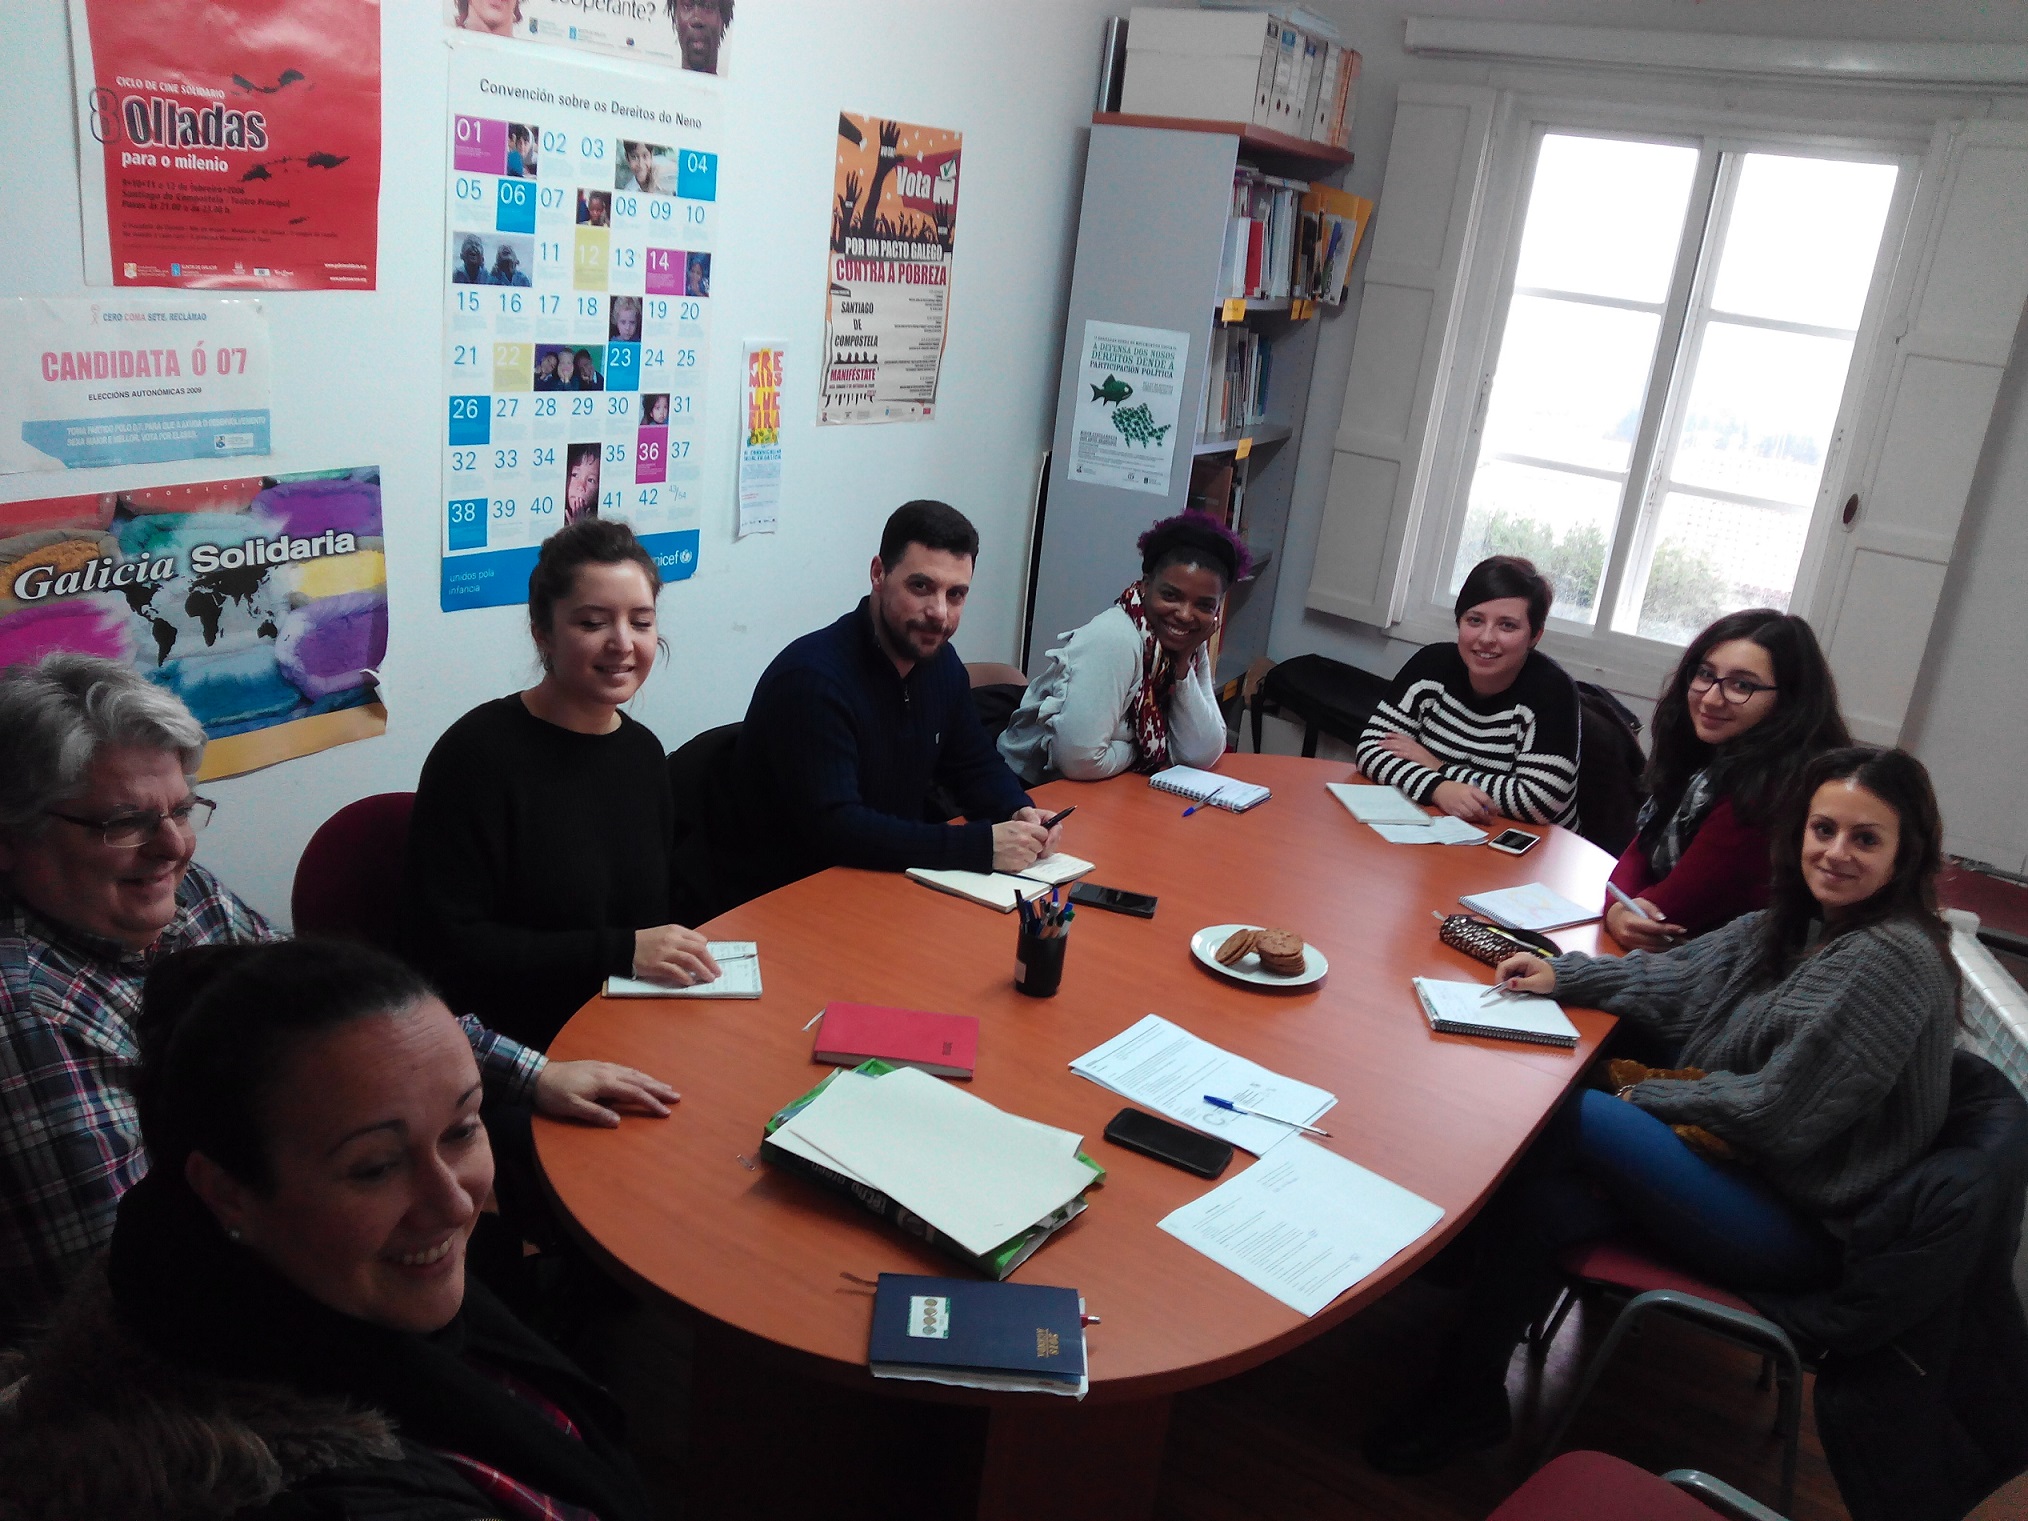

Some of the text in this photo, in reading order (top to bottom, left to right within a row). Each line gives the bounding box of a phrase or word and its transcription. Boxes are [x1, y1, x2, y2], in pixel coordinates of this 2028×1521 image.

[116, 76, 225, 99] CICLO DE CINE SOLIDARIO
[480, 78, 702, 129] Convención sobre os Dereitos do Neno
[122, 95, 268, 152] Olladas
[457, 118, 708, 174] 01 02 03 04
[122, 151, 229, 172] para o milenio
[897, 165, 932, 199] Vota
[456, 178, 705, 224] 05 06 07 08 09 10
[542, 242, 669, 271] 11 12 13 14
[845, 236, 942, 261] POR UN PACTO GALEGO
[836, 258, 947, 286] CONTRA A POBREZA
[103, 313, 123, 321] CERO
[457, 291, 700, 320] 15 16 17 18 19 20
[841, 301, 874, 314] SANTIAGO
[853, 319, 862, 330] DE
[835, 335, 878, 347] COMPOSTELA
[1092, 341, 1098, 349] A
[1134, 348, 1148, 357] DOS
[41, 348, 181, 382] CANDIDATA
[191, 340, 206, 377] Ó
[454, 346, 695, 367] 21 22 23 24 25
[1091, 350, 1174, 370] DEREITOS DENDE A
[88, 391, 130, 401] ELECCIONS
[132, 387, 185, 399] AUTONÓMICAS
[453, 396, 691, 418] 26 27 28 29 30 31
[452, 442, 690, 471] 32 33 34 35 36 37
[451, 503, 476, 523] 38
[493, 499, 515, 519] 39
[530, 496, 553, 514] 40
[603, 491, 623, 508] 41
[639, 488, 658, 506] 42
[14, 530, 355, 600] Galicia Solidaria
[652, 549, 679, 567] nicef
[449, 568, 495, 583] unidos pola
[449, 583, 481, 596] infancia
